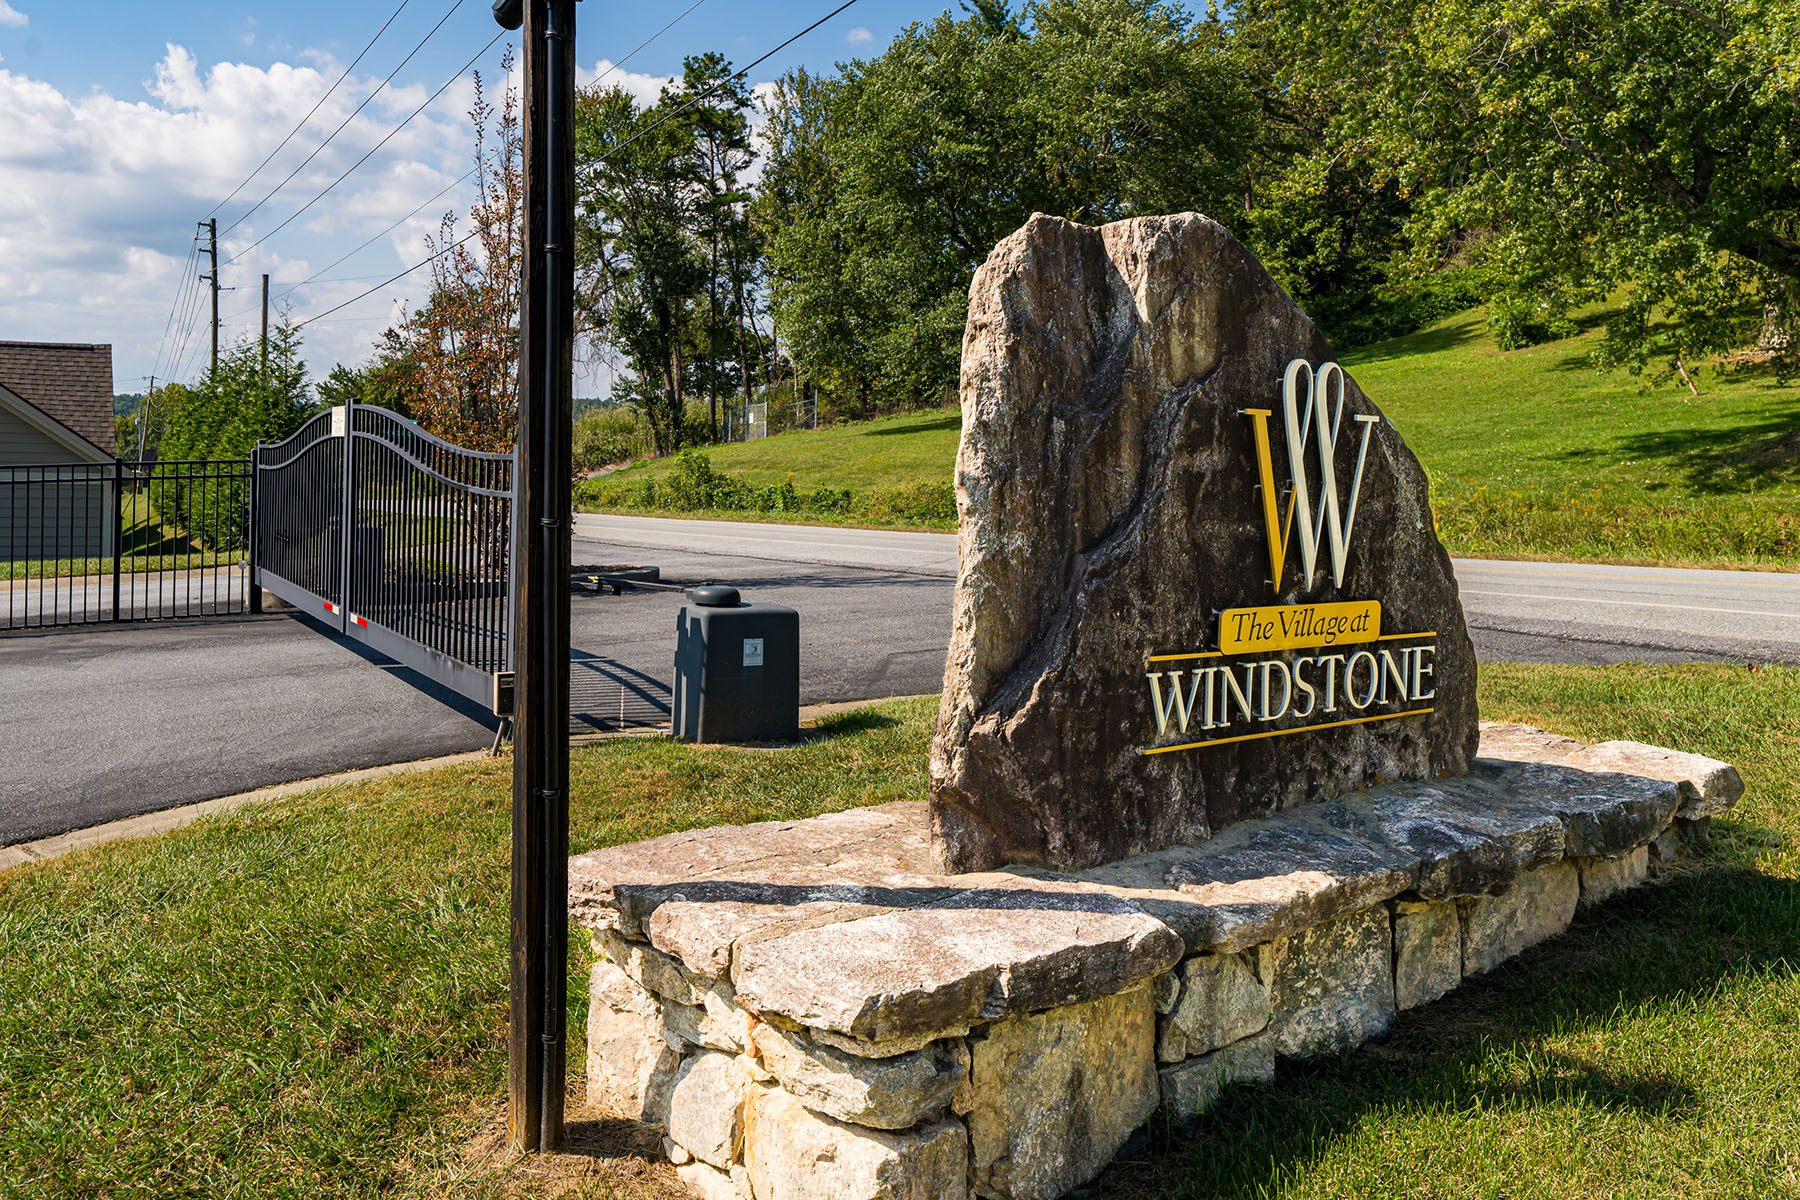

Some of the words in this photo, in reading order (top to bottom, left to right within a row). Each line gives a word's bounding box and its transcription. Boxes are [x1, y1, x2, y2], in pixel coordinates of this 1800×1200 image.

[1232, 612, 1274, 642] The
[1278, 608, 1348, 644] Village
[1350, 609, 1370, 633] at
[1146, 645, 1436, 736] WINDSTONE
